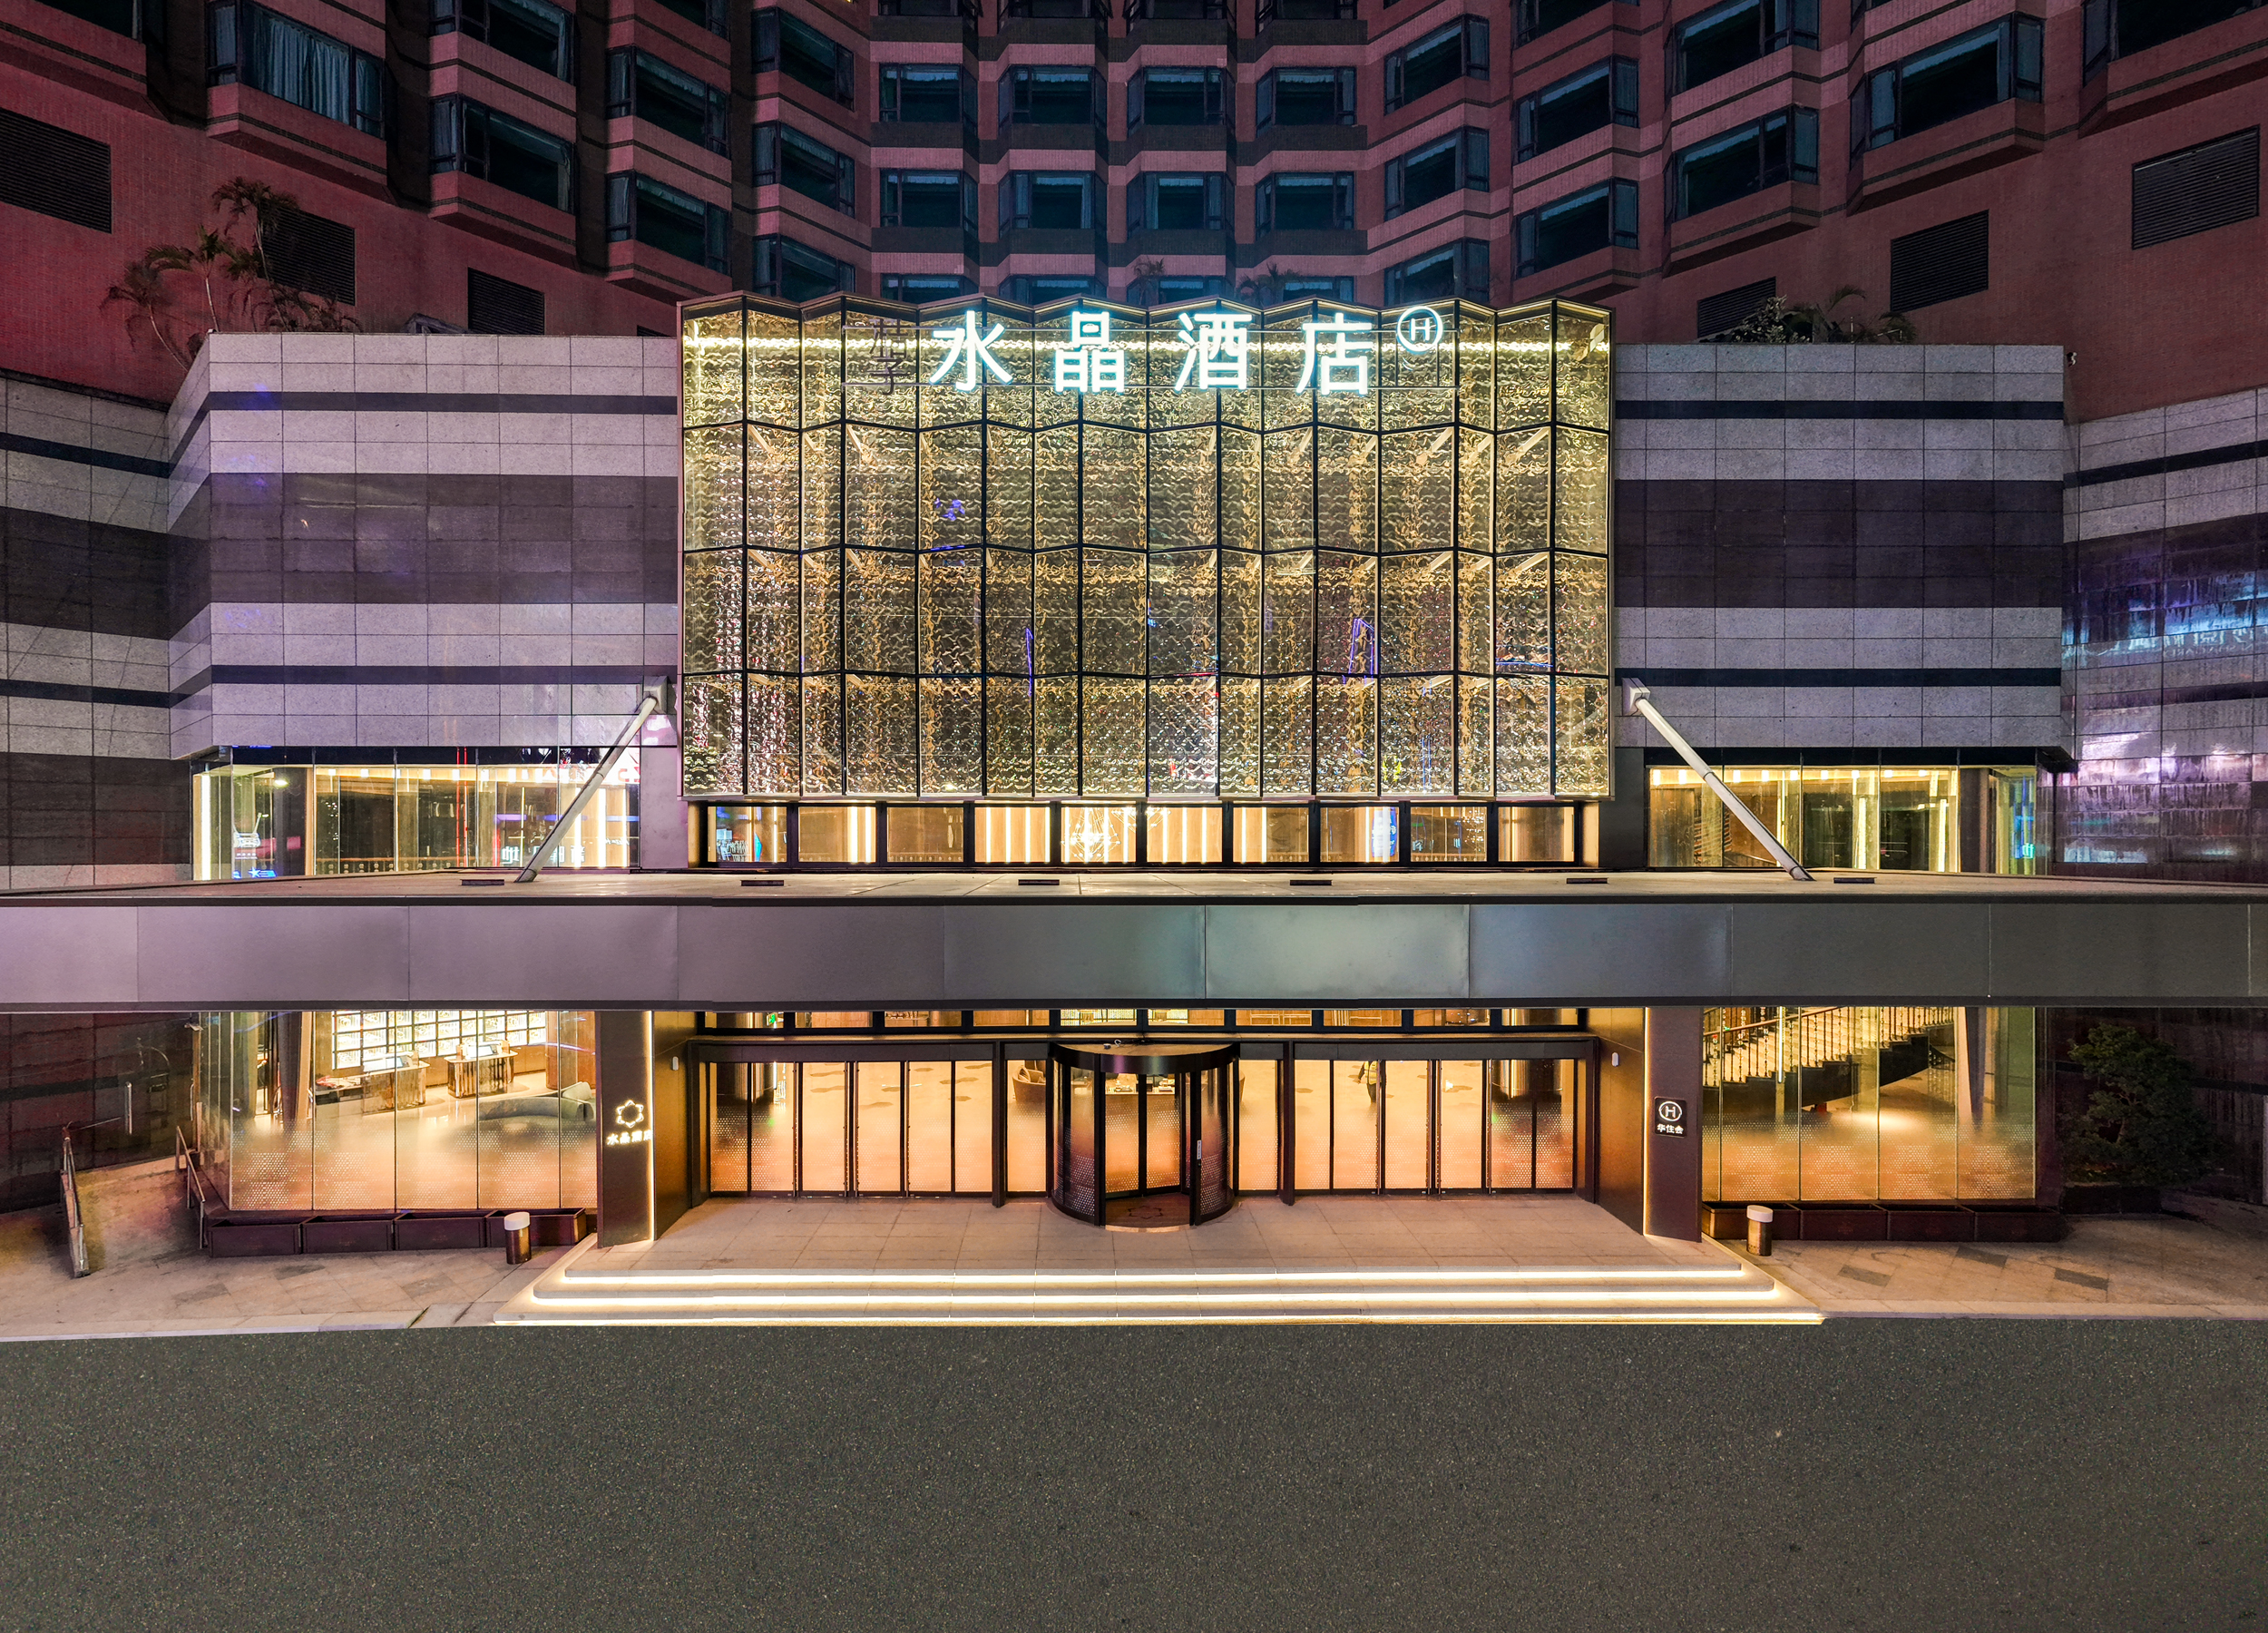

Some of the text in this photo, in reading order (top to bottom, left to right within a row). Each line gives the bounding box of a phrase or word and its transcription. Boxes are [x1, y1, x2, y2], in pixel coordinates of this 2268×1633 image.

[869, 318, 912, 396] 桔子
[929, 309, 1374, 396] 水晶酒店
[1657, 1123, 1684, 1134] 华住会
